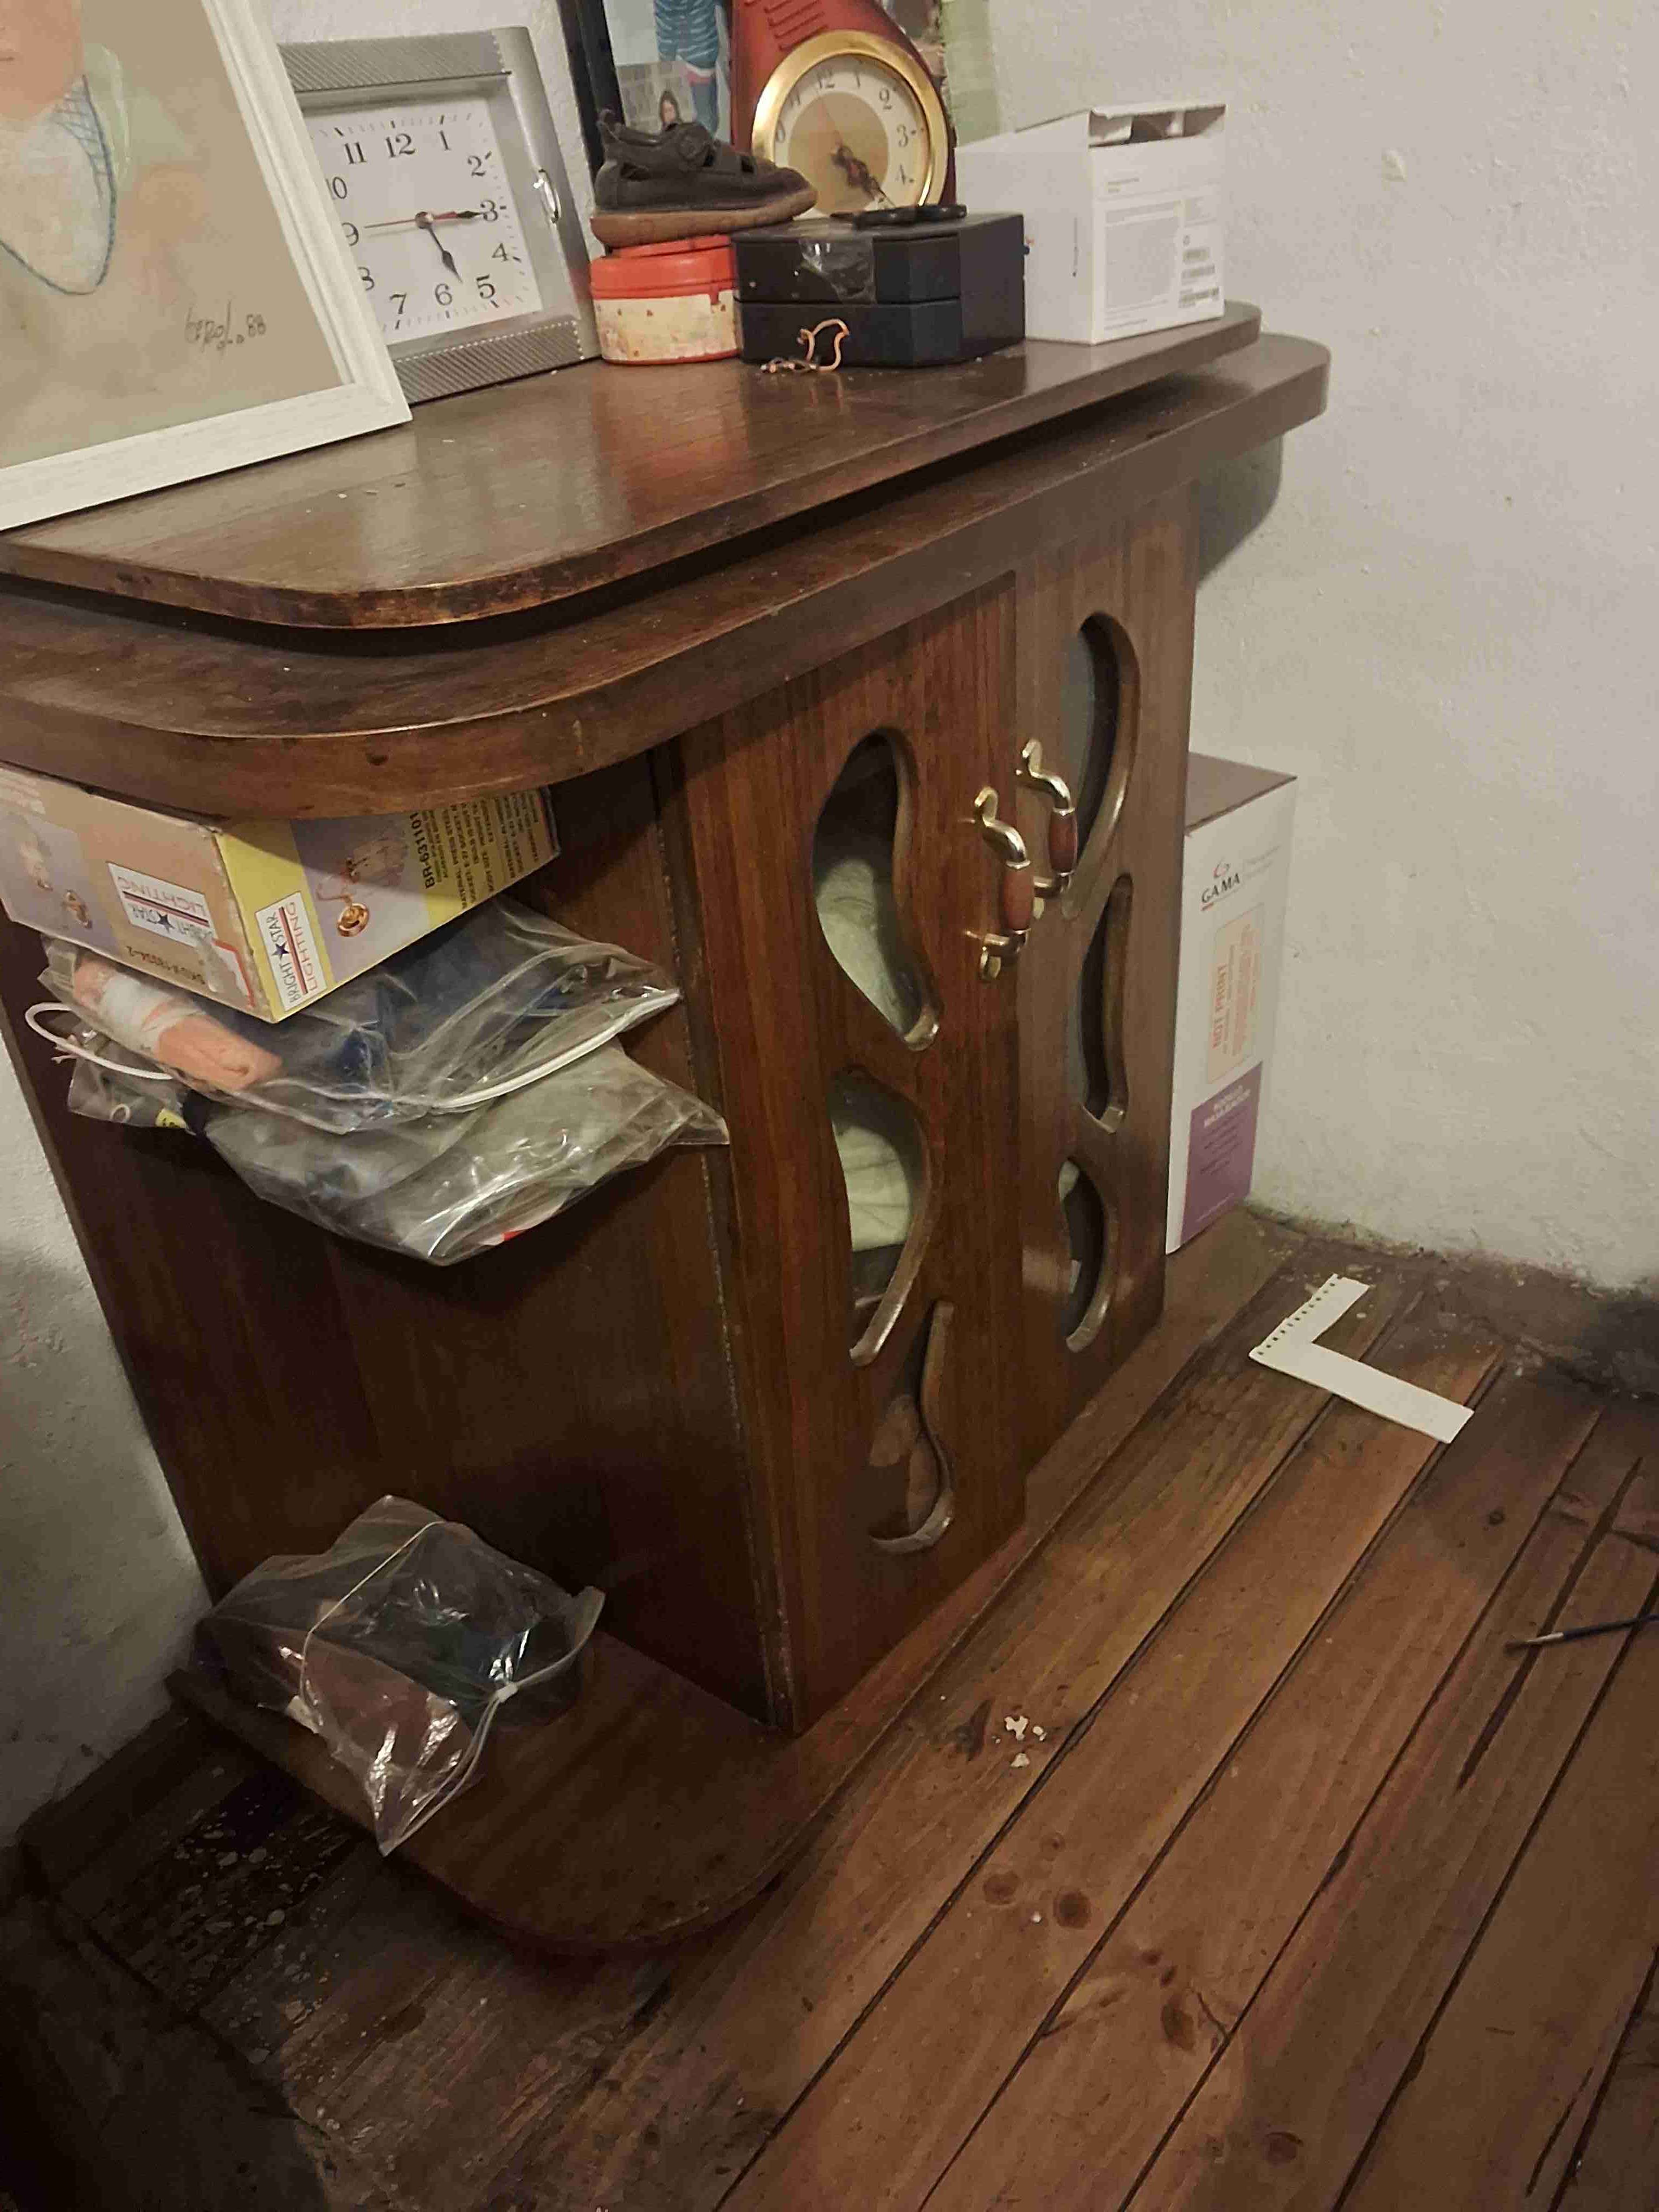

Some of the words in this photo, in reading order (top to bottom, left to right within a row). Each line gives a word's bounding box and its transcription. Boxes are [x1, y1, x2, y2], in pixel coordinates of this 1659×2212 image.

[385, 133, 416, 158] 12
[439, 131, 451, 151] 1
[896, 124, 909, 149] 3
[344, 142, 367, 165] 11
[467, 155, 486, 177] 2
[479, 200, 498, 222] 3
[492, 242, 509, 262] 4
[434, 284, 453, 306] 6
[476, 275, 496, 299] 5
[389, 293, 407, 315] 7
[1201, 872, 1240, 903] GAMA
[266, 911, 286, 943] STAR
[285, 902, 318, 991] LIGHTING
[279, 962, 303, 1004] BRIGHT
